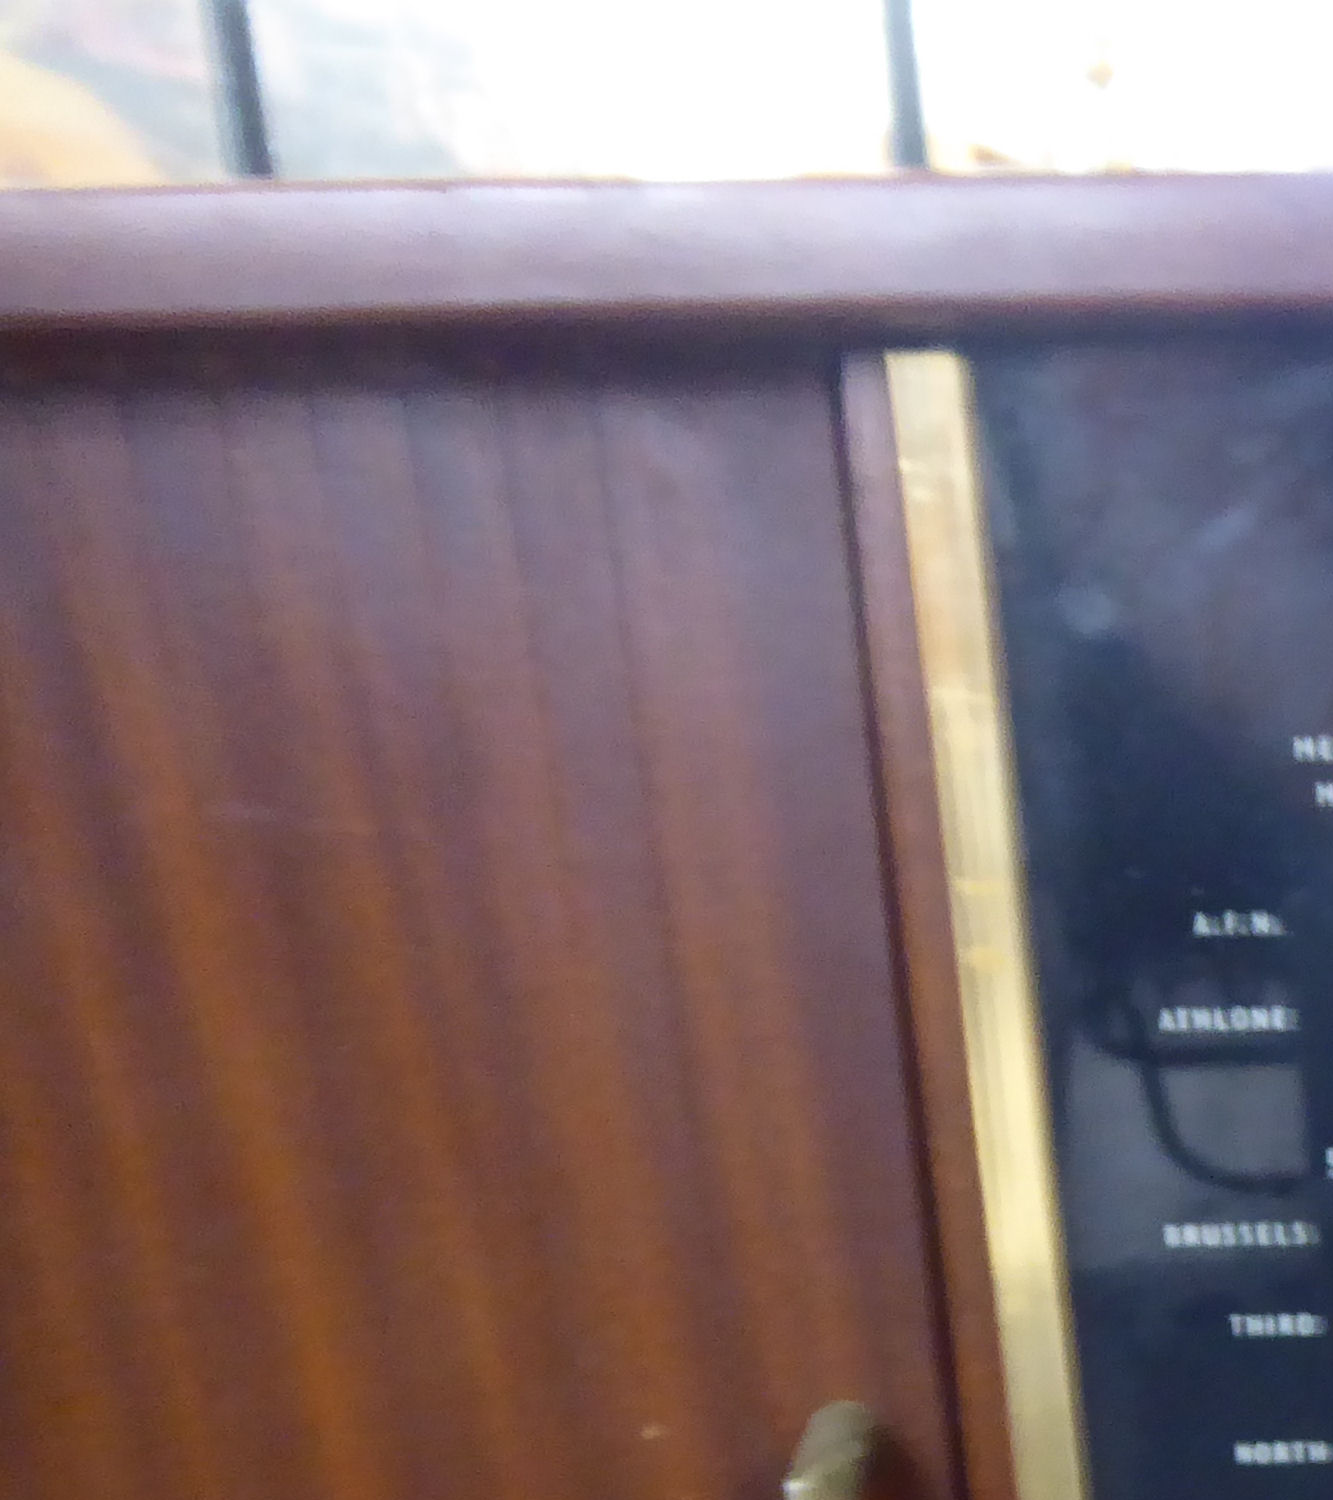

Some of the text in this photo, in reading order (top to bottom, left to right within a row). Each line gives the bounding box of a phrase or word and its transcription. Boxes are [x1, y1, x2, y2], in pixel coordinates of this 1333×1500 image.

[1158, 1000, 1298, 1035] ATHLONE
[1162, 1220, 1319, 1249] BRUSSELS
[1229, 1311, 1326, 1338] THIRD
